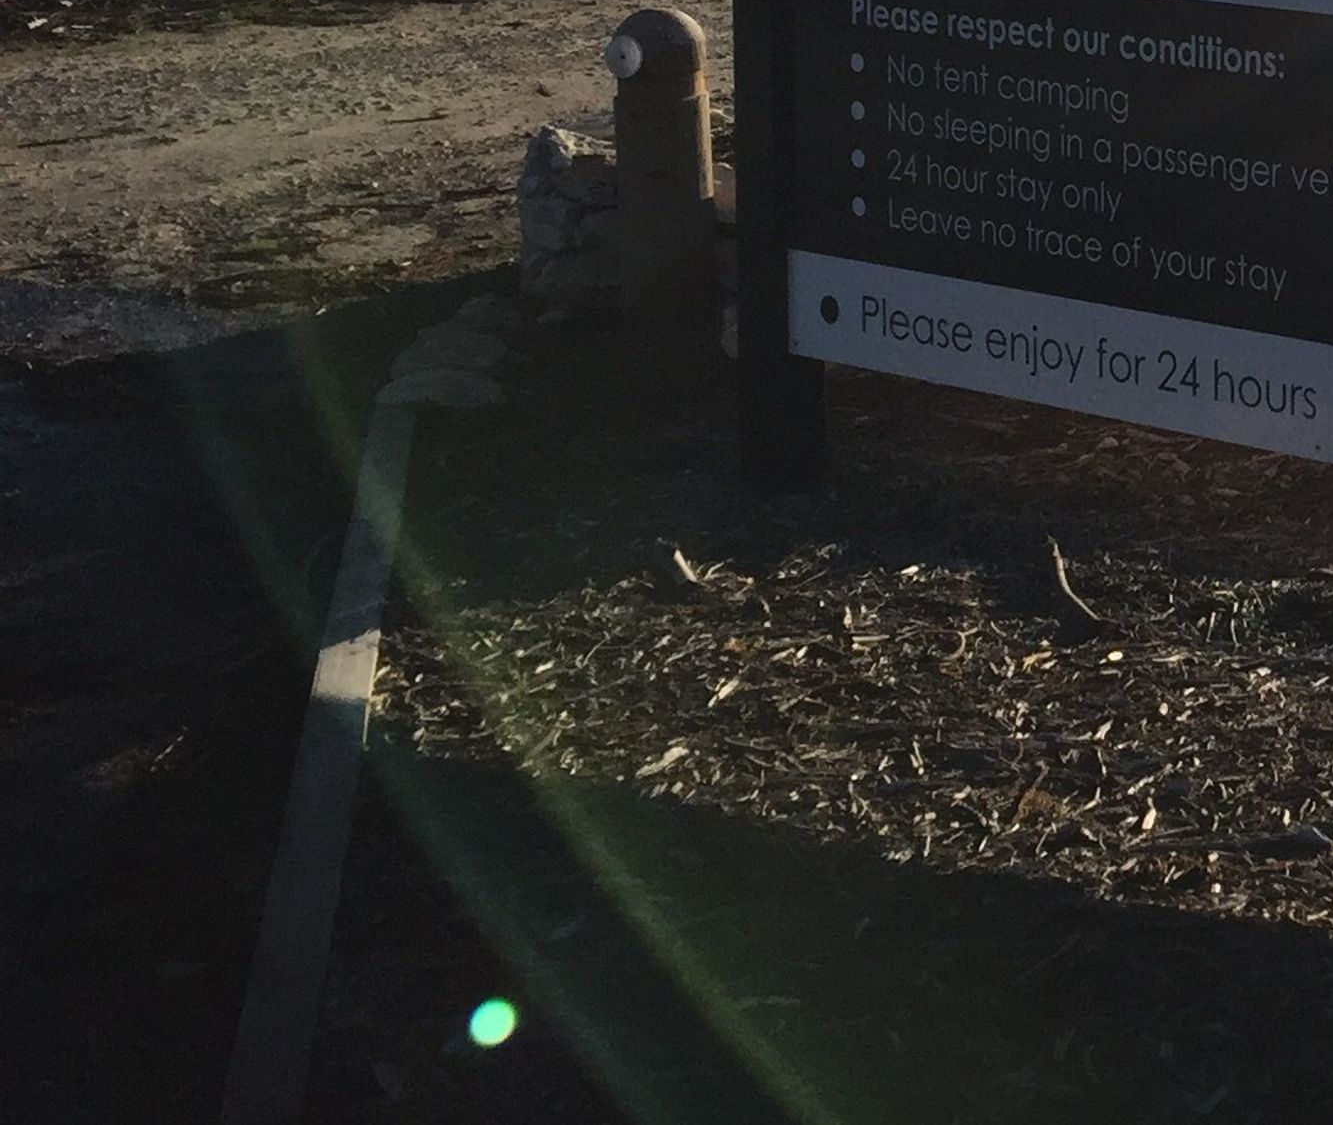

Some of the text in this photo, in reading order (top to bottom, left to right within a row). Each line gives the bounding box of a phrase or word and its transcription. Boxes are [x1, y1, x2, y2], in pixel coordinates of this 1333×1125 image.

[946, 11, 1054, 52] respect
[1062, 29, 1110, 58] our
[1118, 29, 1286, 80] conditions:
[887, 54, 1131, 124] No tent camping
[886, 148, 1122, 222] 24 hour stay only
[887, 102, 925, 135] No
[934, 107, 1051, 163] sleeping
[1060, 124, 1084, 159] in
[1092, 138, 1114, 164] a
[1122, 141, 1281, 192] passenger
[887, 197, 1287, 300] Leave no trace of your stay
[862, 295, 973, 352] Please
[986, 323, 1083, 382] enjoy
[1096, 339, 1144, 385] for
[1157, 349, 1201, 396] 24
[1213, 359, 1317, 420] hours
